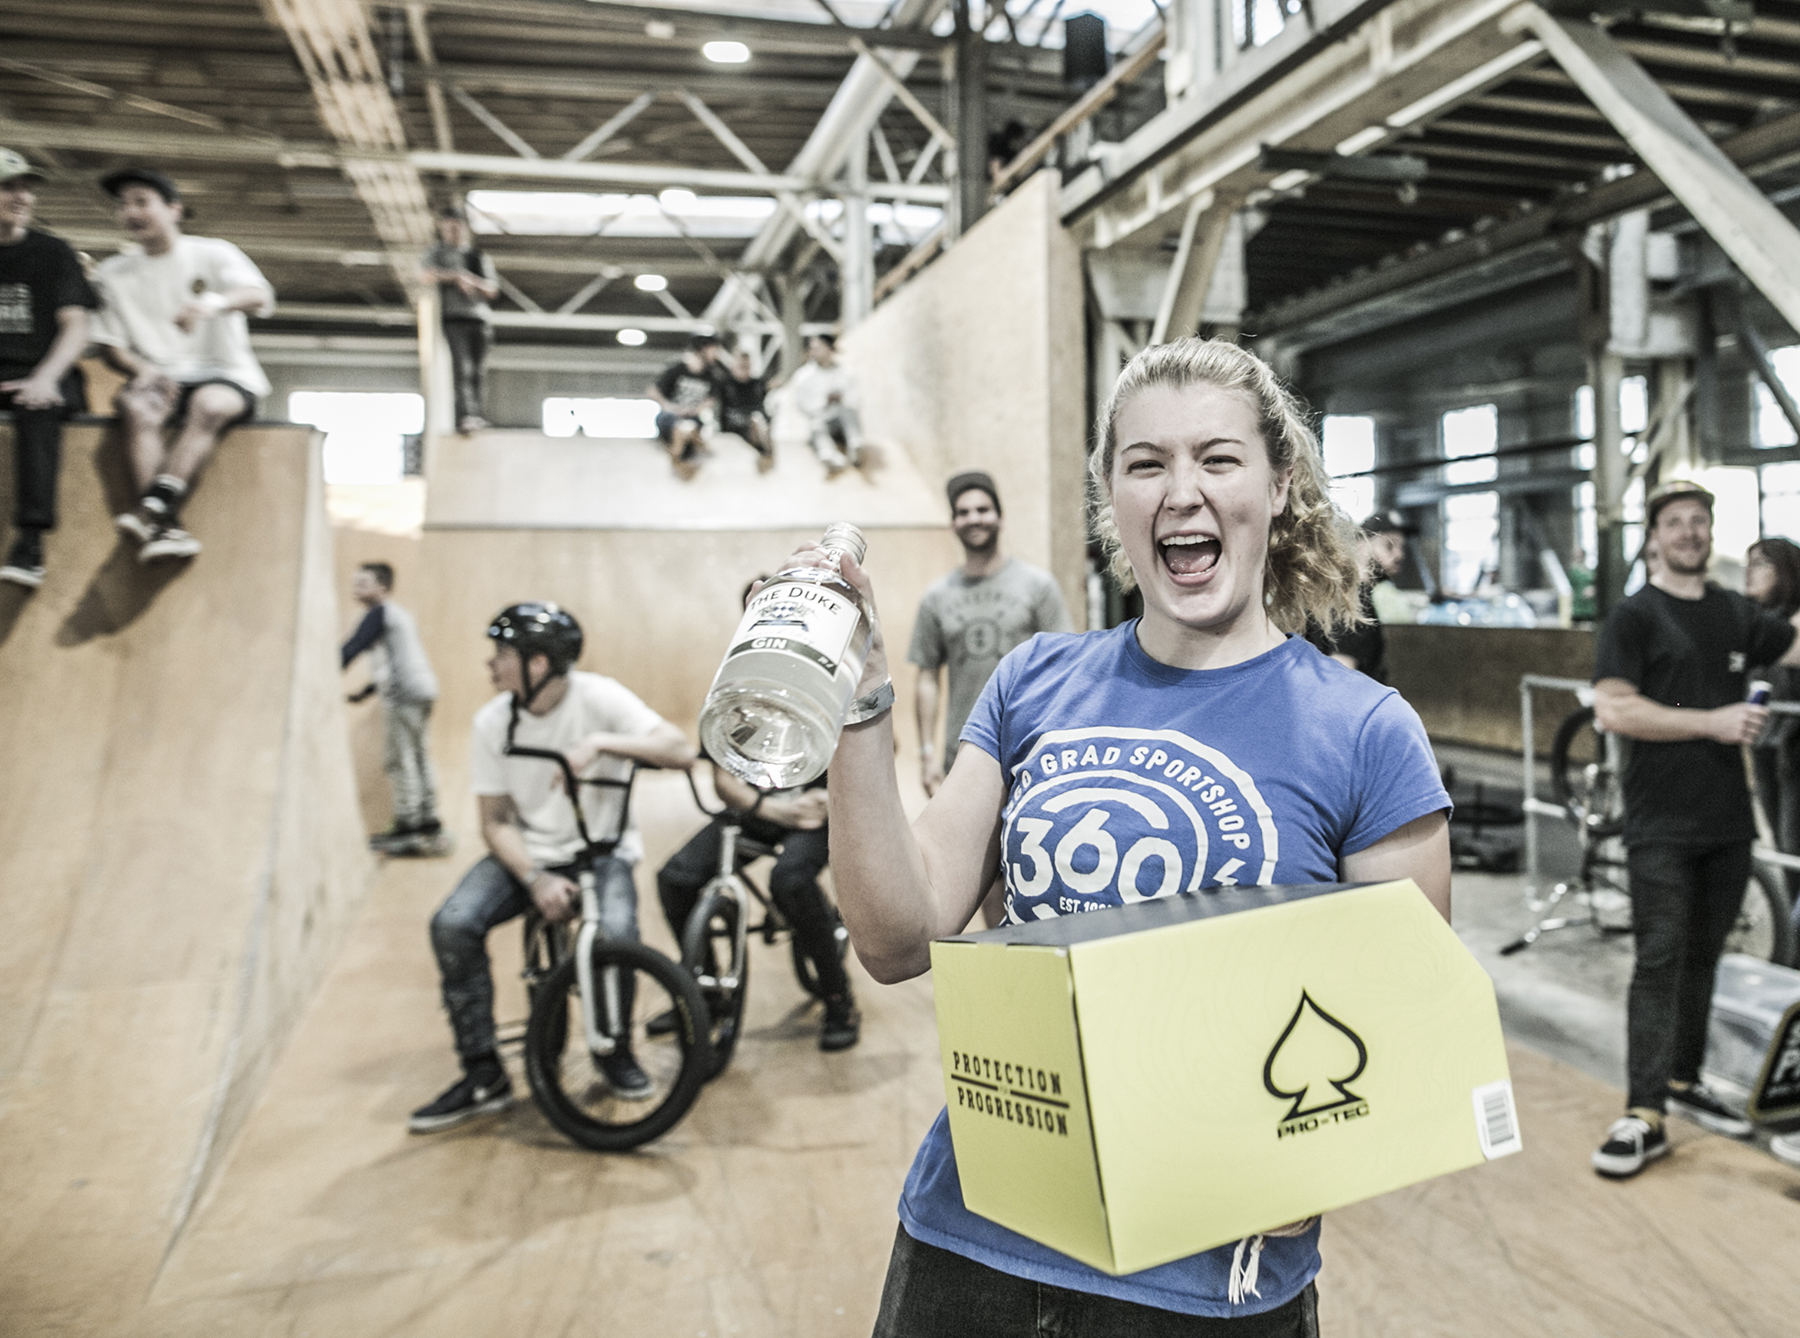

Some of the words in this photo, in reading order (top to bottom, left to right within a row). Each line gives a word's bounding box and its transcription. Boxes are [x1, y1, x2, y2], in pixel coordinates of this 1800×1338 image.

[750, 589, 782, 611] THE
[788, 587, 842, 616] DUKE
[751, 637, 788, 650] GIN
[1040, 745, 1122, 775] GRAD
[1129, 745, 1251, 850] SPORTSHOP
[1012, 808, 1182, 905] 360
[952, 1051, 1063, 1095] PROTECTION
[957, 1086, 1069, 1137] PROGRESSION
[1277, 1104, 1370, 1140] PRO-TEC
